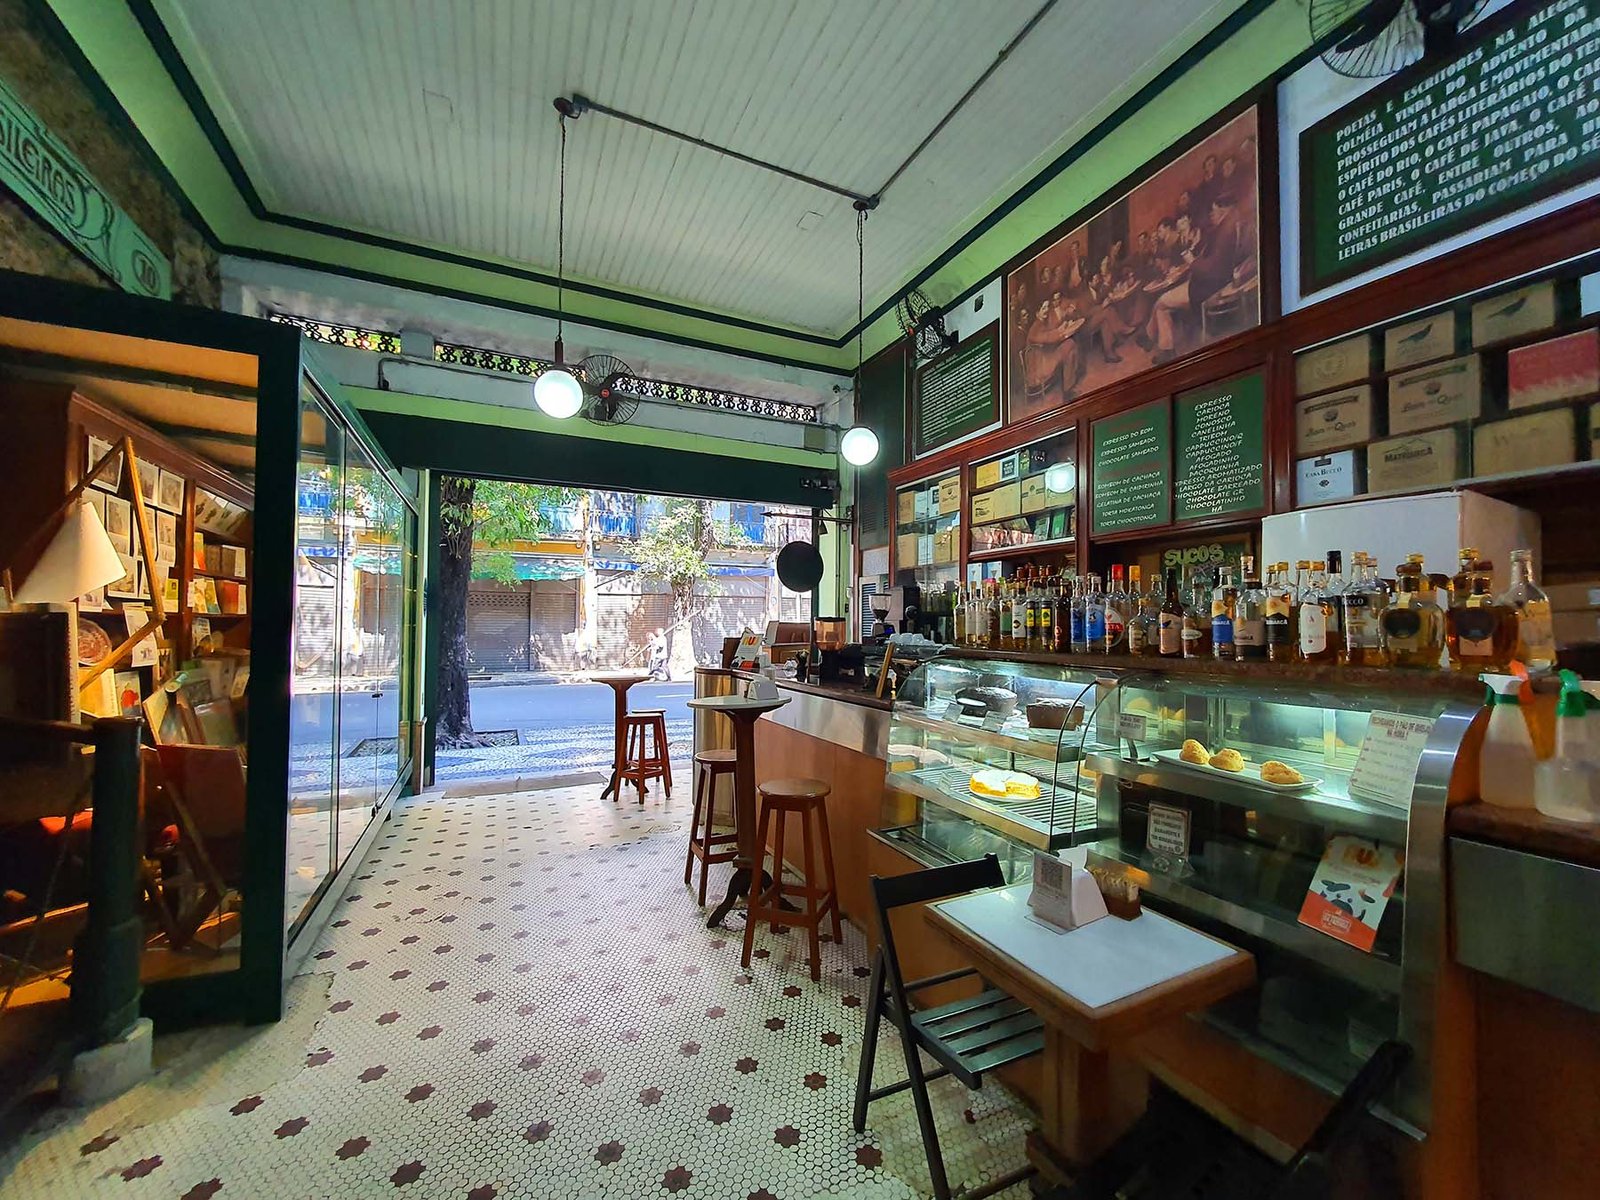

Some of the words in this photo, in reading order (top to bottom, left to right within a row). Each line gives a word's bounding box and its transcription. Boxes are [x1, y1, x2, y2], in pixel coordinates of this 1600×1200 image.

[1337, 122, 1383, 156] COLMÉIA
[1395, 94, 1432, 123] VINDA
[1446, 75, 1466, 96] DO
[1481, 29, 1547, 76] ADVENTO
[1564, 6, 1587, 29] DA
[1337, 110, 1377, 141] POETAS
[1386, 100, 1395, 113] E
[1404, 47, 1483, 102] ESCRITORES
[1495, 28, 1515, 49] NA
[1337, 119, 1417, 171] PROSSEGUIAM
[1420, 113, 1429, 127] A
[1431, 86, 1477, 120] LARGA
[1480, 80, 1489, 94] E
[1338, 151, 1389, 186] ESPÍRITO
[1391, 136, 1415, 159] DOS
[1418, 115, 1455, 143] CAFÉS
[1458, 66, 1545, 123] LITERÁRIOS
[1549, 53, 1573, 75] DO
[1338, 190, 1346, 201] O
[1348, 172, 1374, 195] CAFÉ
[1377, 165, 1393, 182] DO
[1425, 144, 1434, 157] O
[1437, 124, 1469, 151] CAFÉ
[1557, 75, 1570, 89] O
[1339, 193, 1363, 215] CAFÉ
[1411, 168, 1420, 180] O
[1425, 147, 1455, 174] CAFÉ
[1460, 138, 1480, 157] DE
[1530, 108, 1541, 122] O
[1547, 81, 1586, 113] CAFÉ
[1339, 201, 1384, 231] GRANDE
[1438, 155, 1480, 185] ENTRE
[1576, 98, 1599, 119] AO
[1432, 157, 1512, 204] PASSARIAM
[1524, 132, 1568, 162] PARA
[1338, 234, 1378, 261] LETRAS
[1380, 198, 1462, 243] BRASILEIRAS
[1465, 188, 1485, 206] DO
[1488, 159, 1550, 195] COMEÇO
[1553, 146, 1578, 167] DO
[1194, 394, 1232, 411] EXPRESSO
[1196, 402, 1230, 417] CARIOCA
[1194, 415, 1232, 430] CONOSCO
[1196, 409, 1230, 423] MORENO
[1191, 420, 1236, 438] CANELINHA
[1103, 434, 1130, 447] EXPRESSO
[1101, 445, 1128, 457] EXPRESSO
[1195, 449, 1232, 463] AFOGADO
[1098, 453, 1130, 467] CHOCOLATE
[1189, 454, 1240, 471] AFOGADINHO
[1175, 475, 1206, 487] XPRESSO
[1207, 463, 1263, 480] AROMATIZADO
[1179, 483, 1203, 493] LARGO
[1204, 480, 1215, 488] DA
[1217, 472, 1252, 485] CARIOCA
[1175, 487, 1215, 499] HOCOLATE
[1186, 491, 1230, 504] CHOCOLATE
[1097, 498, 1122, 508] GELATINA
[1185, 495, 1246, 511] CHOCOLATINHO
[1164, 543, 1225, 566] SUCOS
